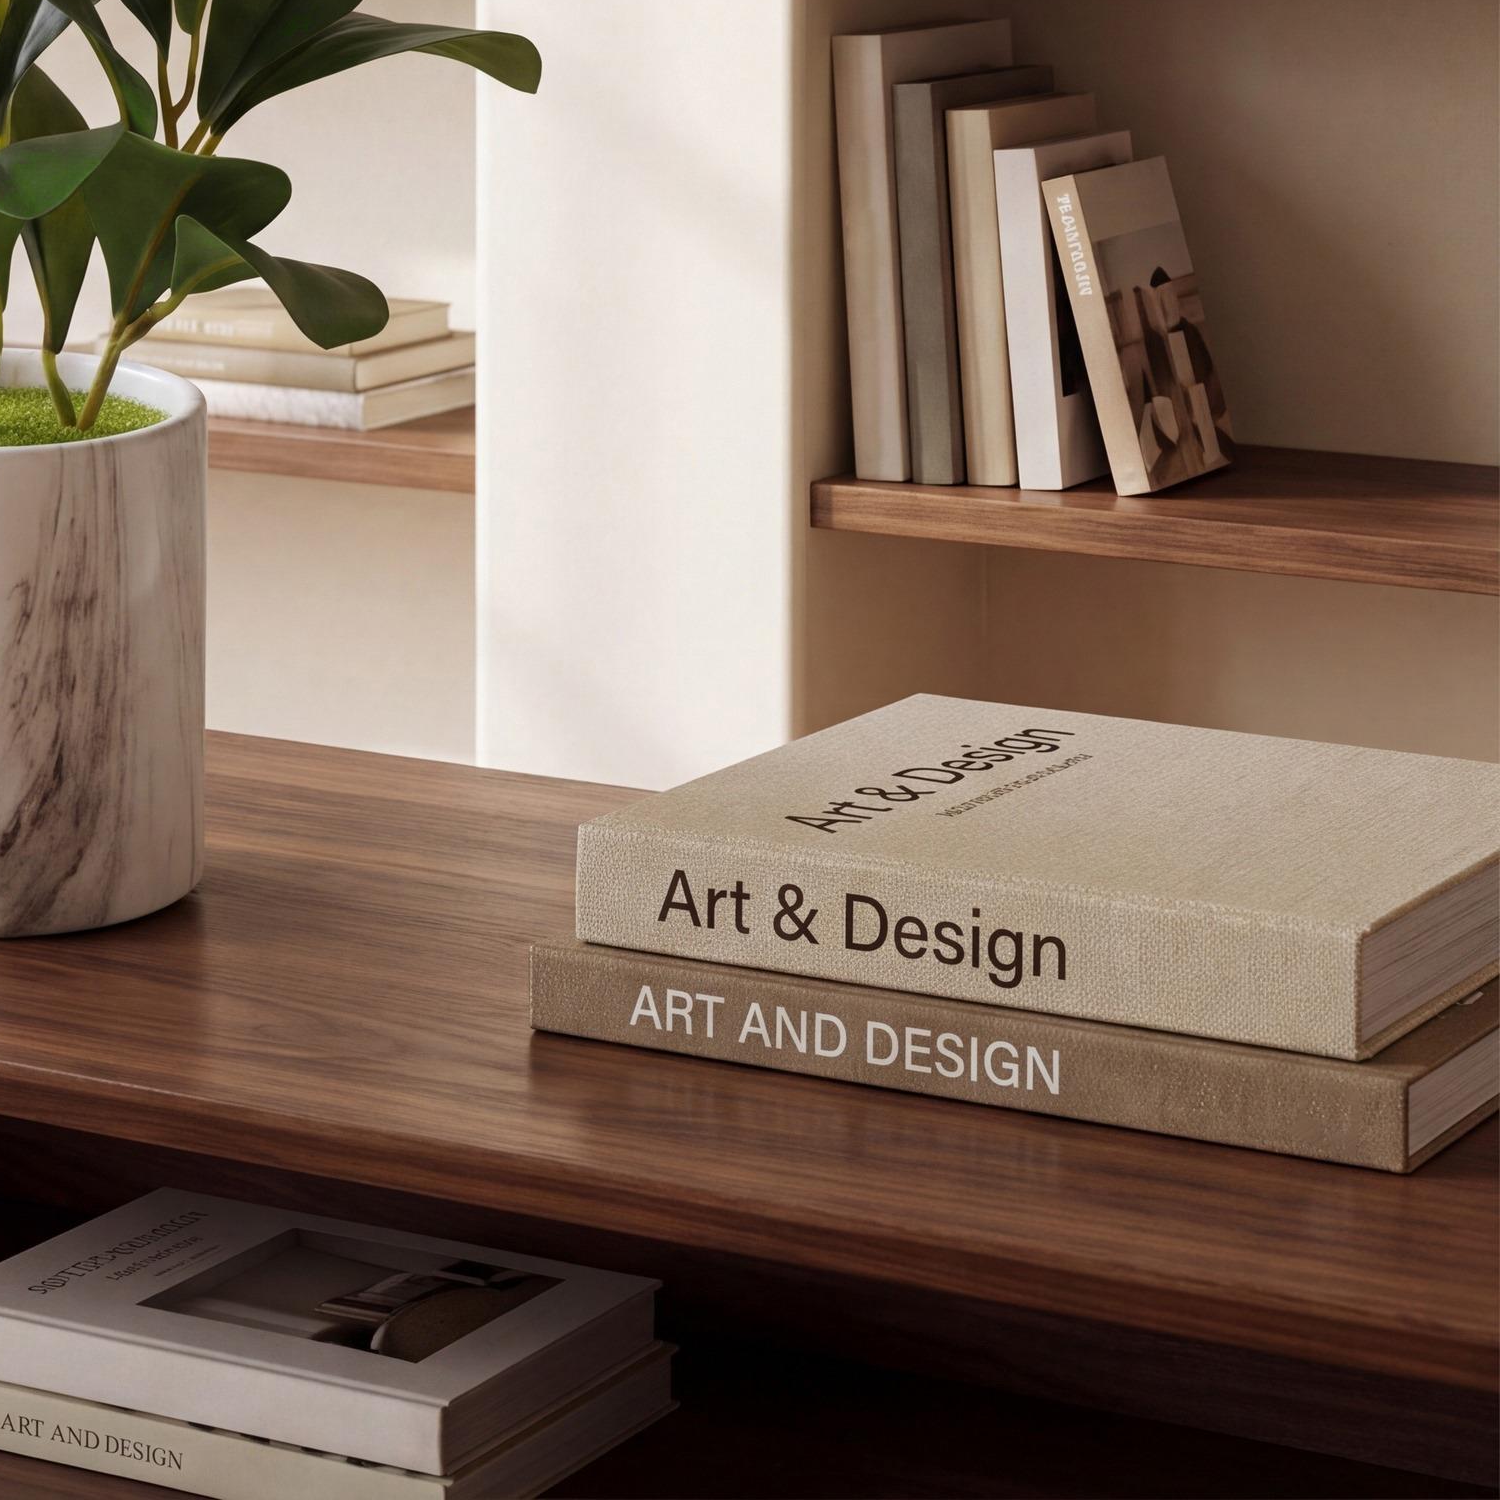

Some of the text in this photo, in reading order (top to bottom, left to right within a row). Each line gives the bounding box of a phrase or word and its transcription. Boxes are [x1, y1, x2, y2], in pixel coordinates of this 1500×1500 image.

[891, 728, 1076, 785] Design
[785, 801, 894, 833] Art
[854, 785, 937, 802] &
[657, 868, 1068, 989] Art & Design
[629, 984, 1060, 1095] ART AND DESIGN
[0, 1413, 184, 1471] ART AND DESIGN
